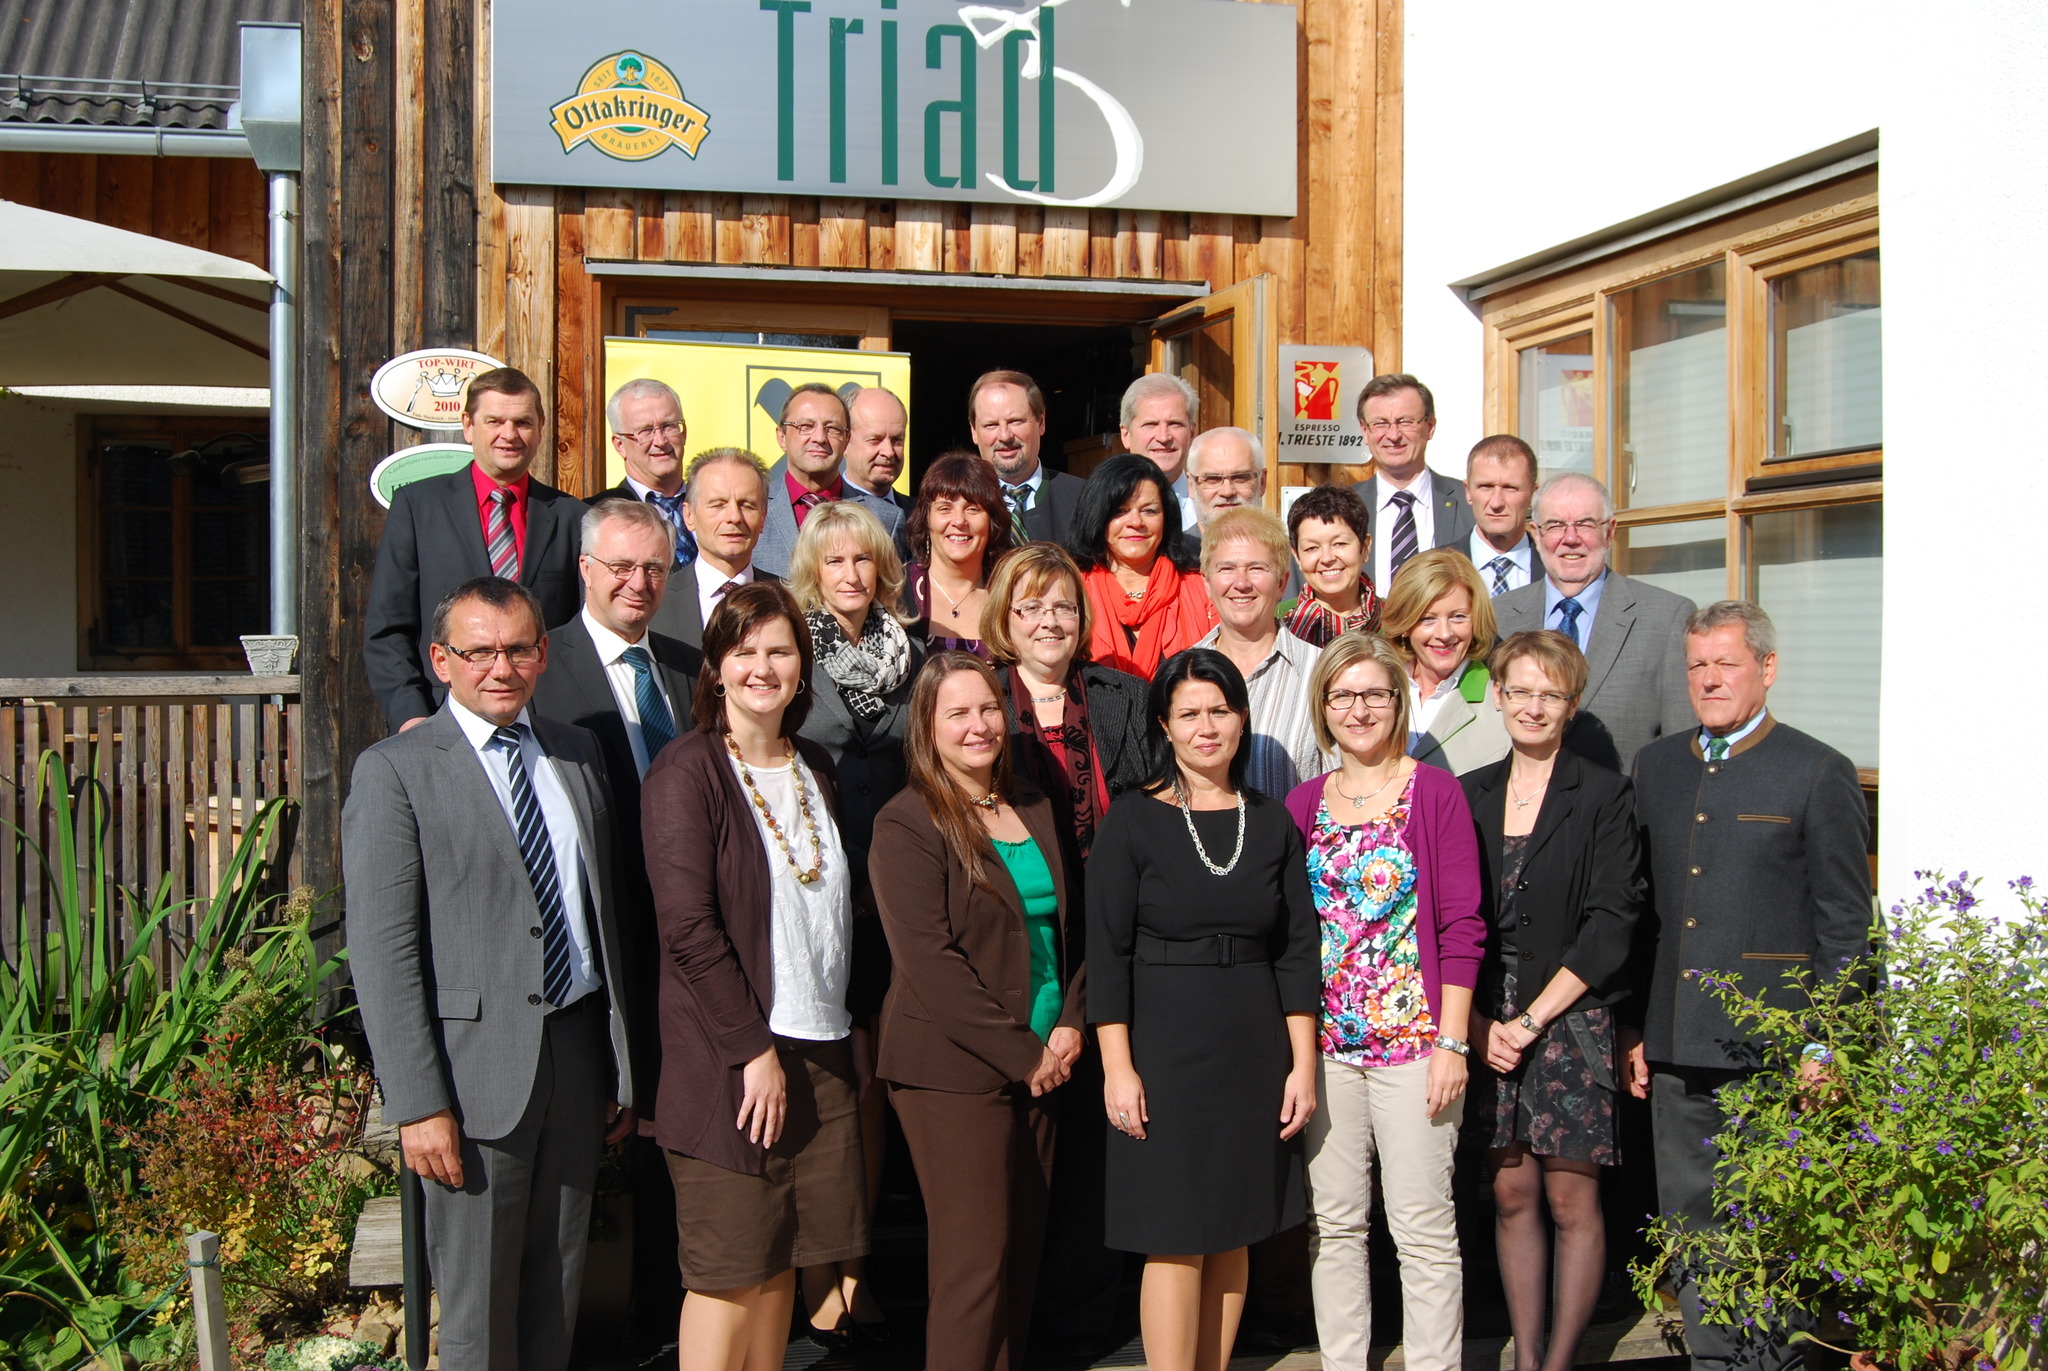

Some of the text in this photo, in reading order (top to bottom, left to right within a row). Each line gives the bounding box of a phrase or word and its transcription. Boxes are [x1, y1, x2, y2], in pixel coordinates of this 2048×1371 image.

[593, 69, 669, 92] SEIT 1837
[760, 0, 1055, 192] Triad
[564, 93, 696, 133] Ottakringer
[601, 132, 660, 151] BRAUEREI
[417, 358, 476, 369] TOP-WIRT
[434, 401, 461, 412] 2010
[1294, 424, 1341, 432] ESPRESSO
[1287, 434, 1336, 446] TRIESTE
[1338, 435, 1364, 447] 1892
